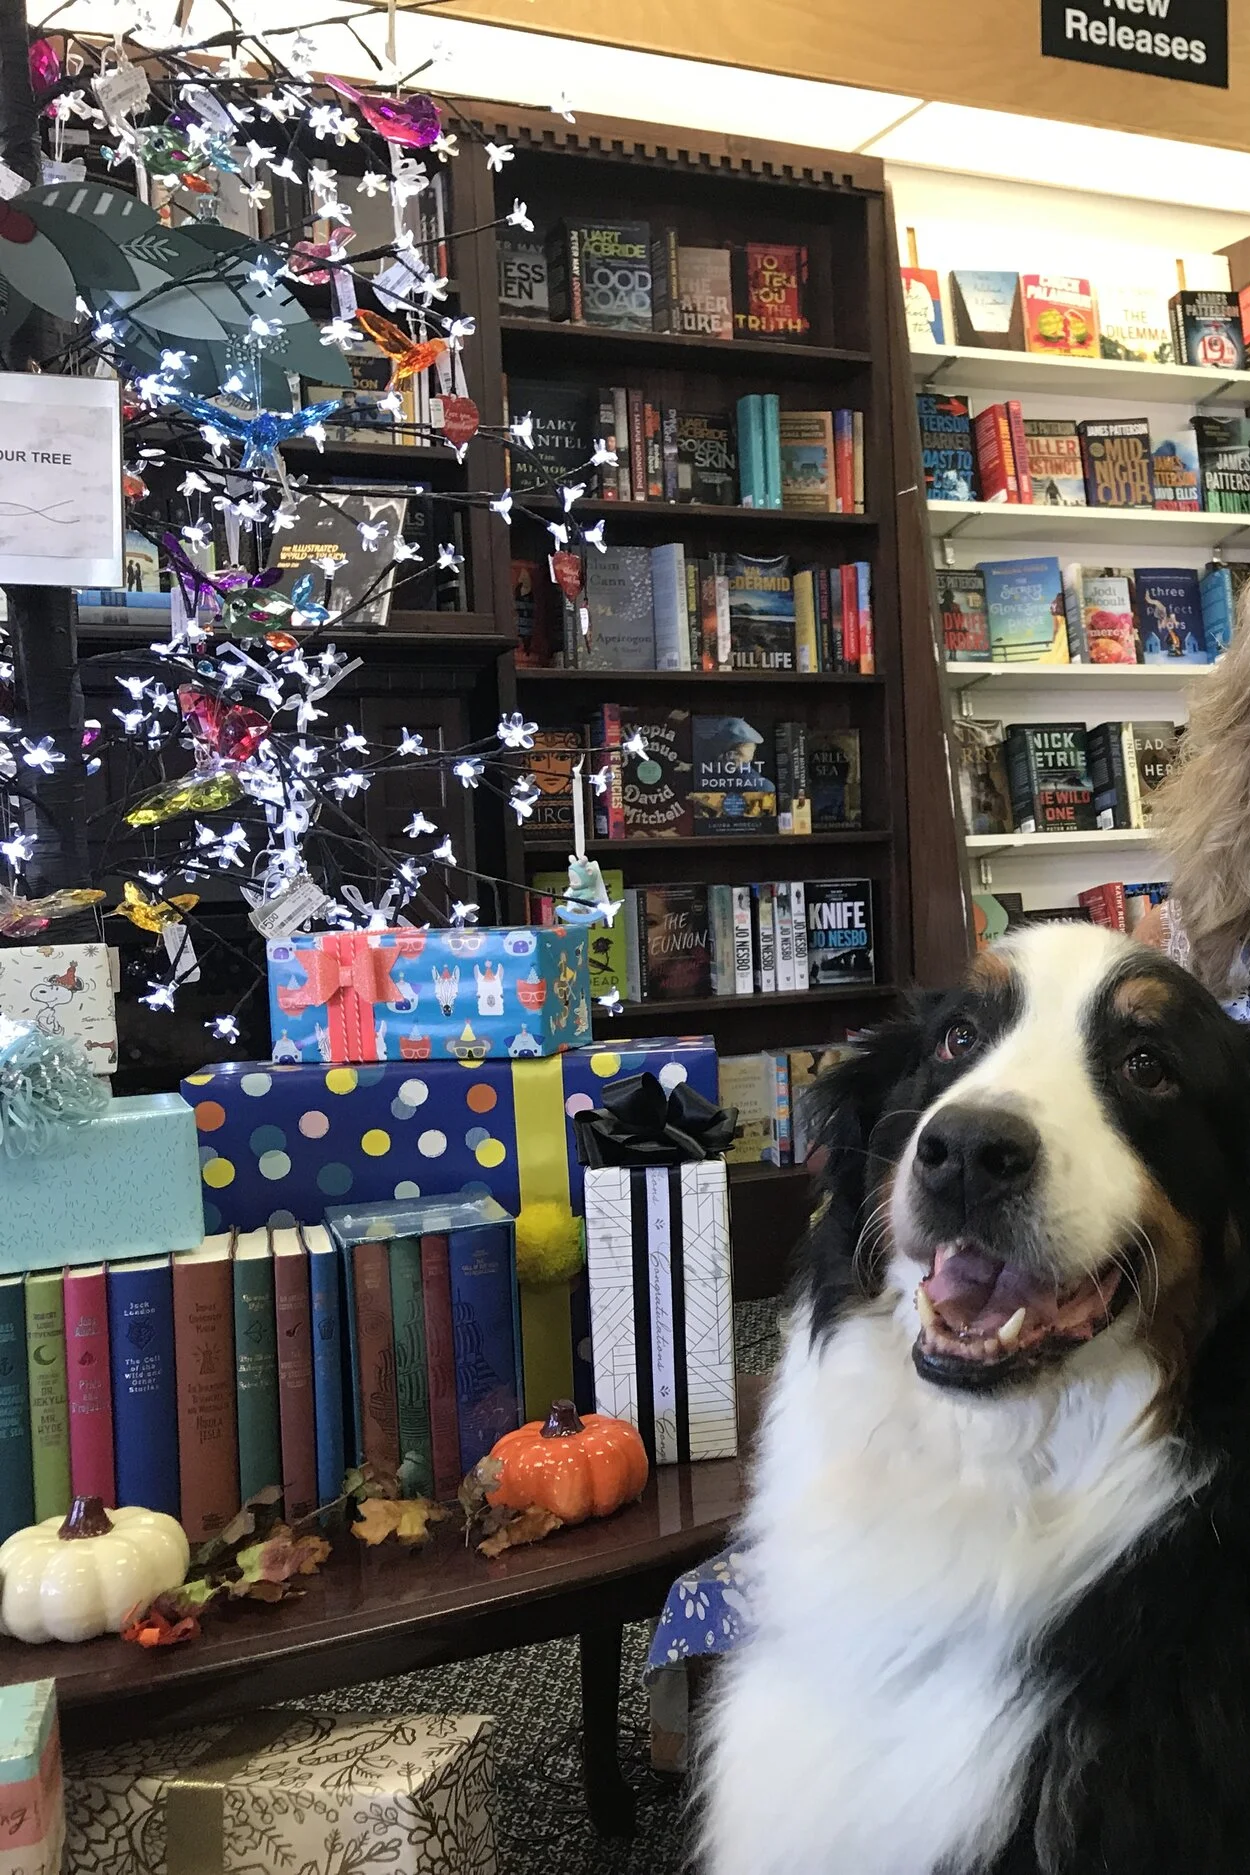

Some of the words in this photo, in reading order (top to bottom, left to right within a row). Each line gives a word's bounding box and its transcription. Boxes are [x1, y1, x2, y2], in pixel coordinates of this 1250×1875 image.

[1065, 8, 1207, 64] Releases
[755, 255, 778, 269] TO
[1196, 293, 1228, 305] JAMES
[1124, 309, 1147, 323] THE
[1185, 305, 1239, 317] PATTERSON
[735, 314, 803, 333] TRUTH
[1106, 325, 1168, 340] DILEMMA
[514, 415, 577, 431] HLARY
[1087, 425, 1109, 436] JAMES
[1110, 423, 1148, 436] PATTERSON
[924, 433, 971, 450] BARKER
[31, 452, 72, 465] TREE
[695, 452, 736, 469] SKIN
[957, 452, 972, 469] TO
[1218, 453, 1250, 471] JAMES
[635, 445, 645, 489] MOONSTONE
[1095, 459, 1150, 483] NIGHT
[1176, 488, 1198, 500] ELLIS
[292, 544, 338, 553] ILLUSTRATED
[280, 552, 307, 560] WORLD
[1091, 586, 1117, 597] Jodi
[1151, 587, 1186, 598] three
[596, 633, 652, 645] Apeirogon
[1090, 629, 1127, 639] mercy
[762, 652, 793, 668] LIFE
[1034, 733, 1075, 748] NICK
[1136, 739, 1164, 751] EAD
[1035, 751, 1087, 767] ETRIE
[702, 761, 765, 774] NIGHT
[702, 778, 766, 788] PORTRAIT
[623, 784, 675, 804] David
[1056, 790, 1090, 804] WILD
[623, 802, 686, 825] Mitchell
[1046, 807, 1075, 820] ONE
[1114, 885, 1123, 911] KATHY
[664, 912, 689, 930] THE
[809, 901, 867, 930] KNIFE
[736, 926, 749, 937] JO
[780, 926, 791, 936] JO
[794, 920, 805, 931] JO
[649, 930, 708, 956] EUNION
[761, 932, 774, 944] JO
[810, 931, 826, 948] JO
[976, 932, 998, 942] THE
[130, 1301, 150, 1310] Jack
[650, 1240, 668, 1374] Congratulations
[123, 1308, 156, 1317] London
[125, 1358, 140, 1366] The
[143, 1355, 160, 1364] Call
[130, 1365, 139, 1373] of
[142, 1363, 156, 1371] the
[124, 1371, 144, 1380] Wild
[128, 1384, 160, 1394] Stories
[37, 1424, 63, 1433] HYDE
